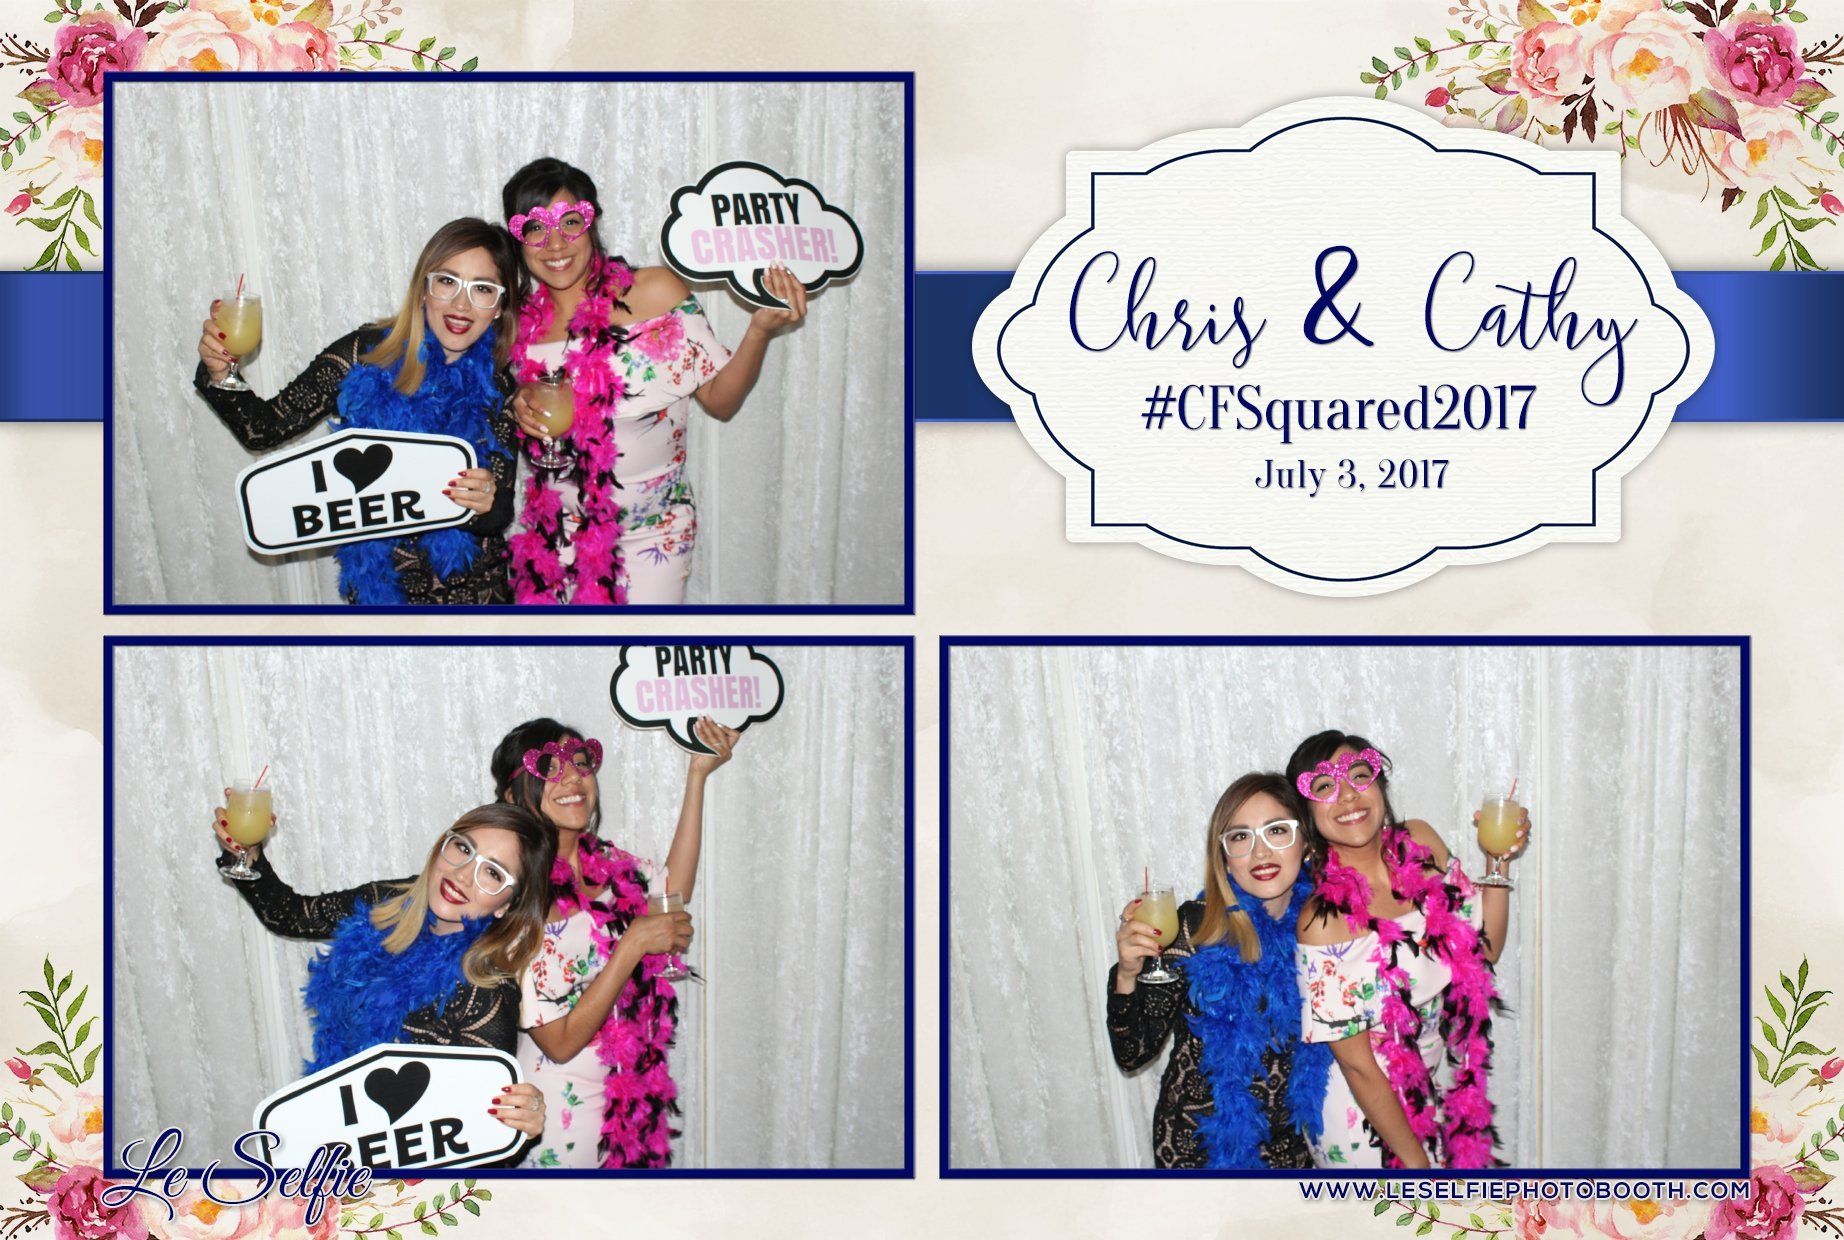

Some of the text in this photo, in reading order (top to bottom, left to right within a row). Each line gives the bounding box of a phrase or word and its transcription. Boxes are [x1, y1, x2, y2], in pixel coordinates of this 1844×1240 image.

[711, 193, 800, 226] PARTY
[691, 226, 838, 264] CRASHER!
[311, 460, 327, 493] I
[292, 491, 425, 537] BEER
[655, 646, 731, 677] PARTY
[635, 676, 762, 713] CRASHER!
[340, 1084, 358, 1126] I
